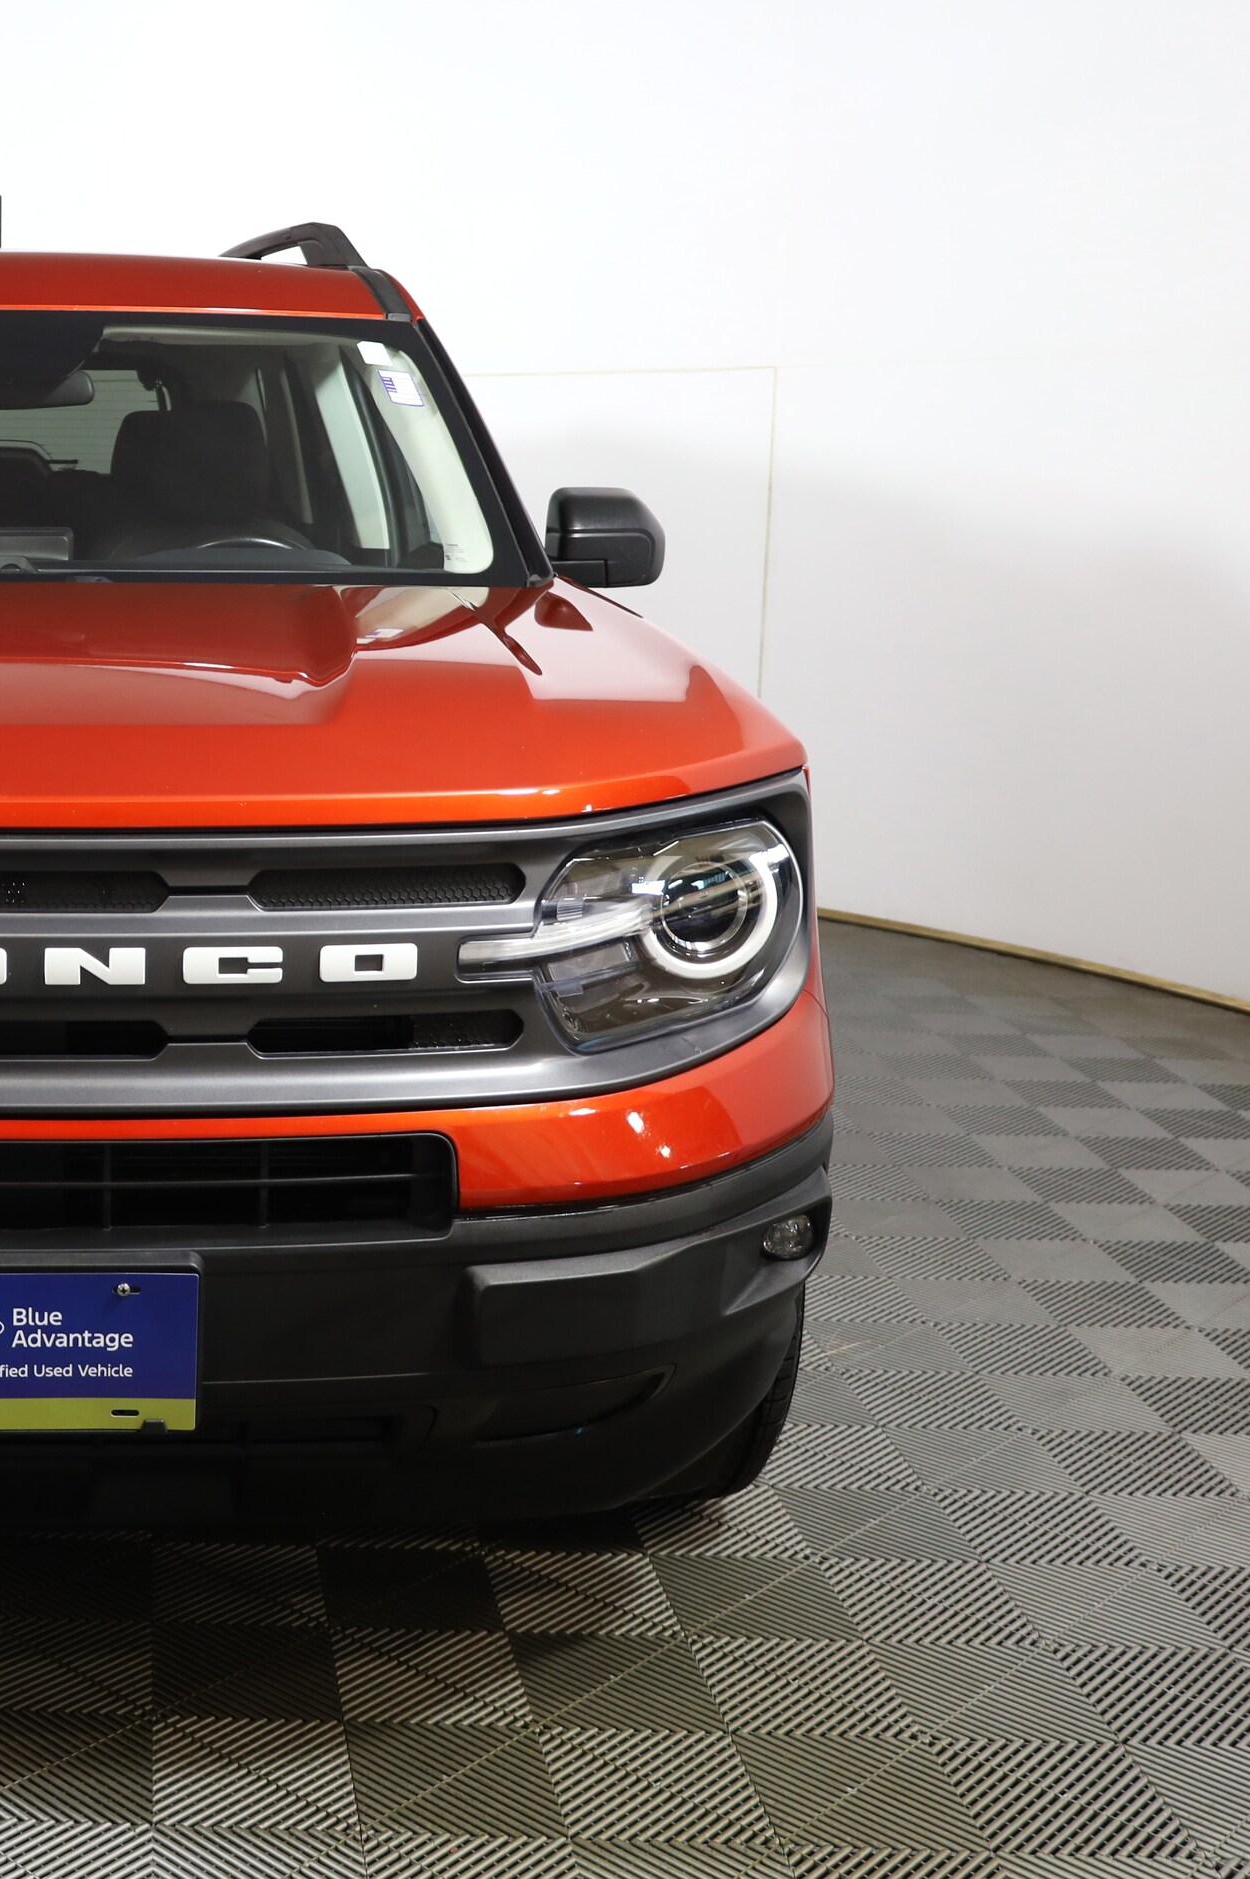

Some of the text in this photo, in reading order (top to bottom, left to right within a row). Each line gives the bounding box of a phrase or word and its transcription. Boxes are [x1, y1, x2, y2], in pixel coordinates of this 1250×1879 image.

[12, 1307, 63, 1326] Blue
[11, 1329, 134, 1351] Advantage
[33, 1363, 73, 1378] Used
[77, 1363, 134, 1378] Vehicle
